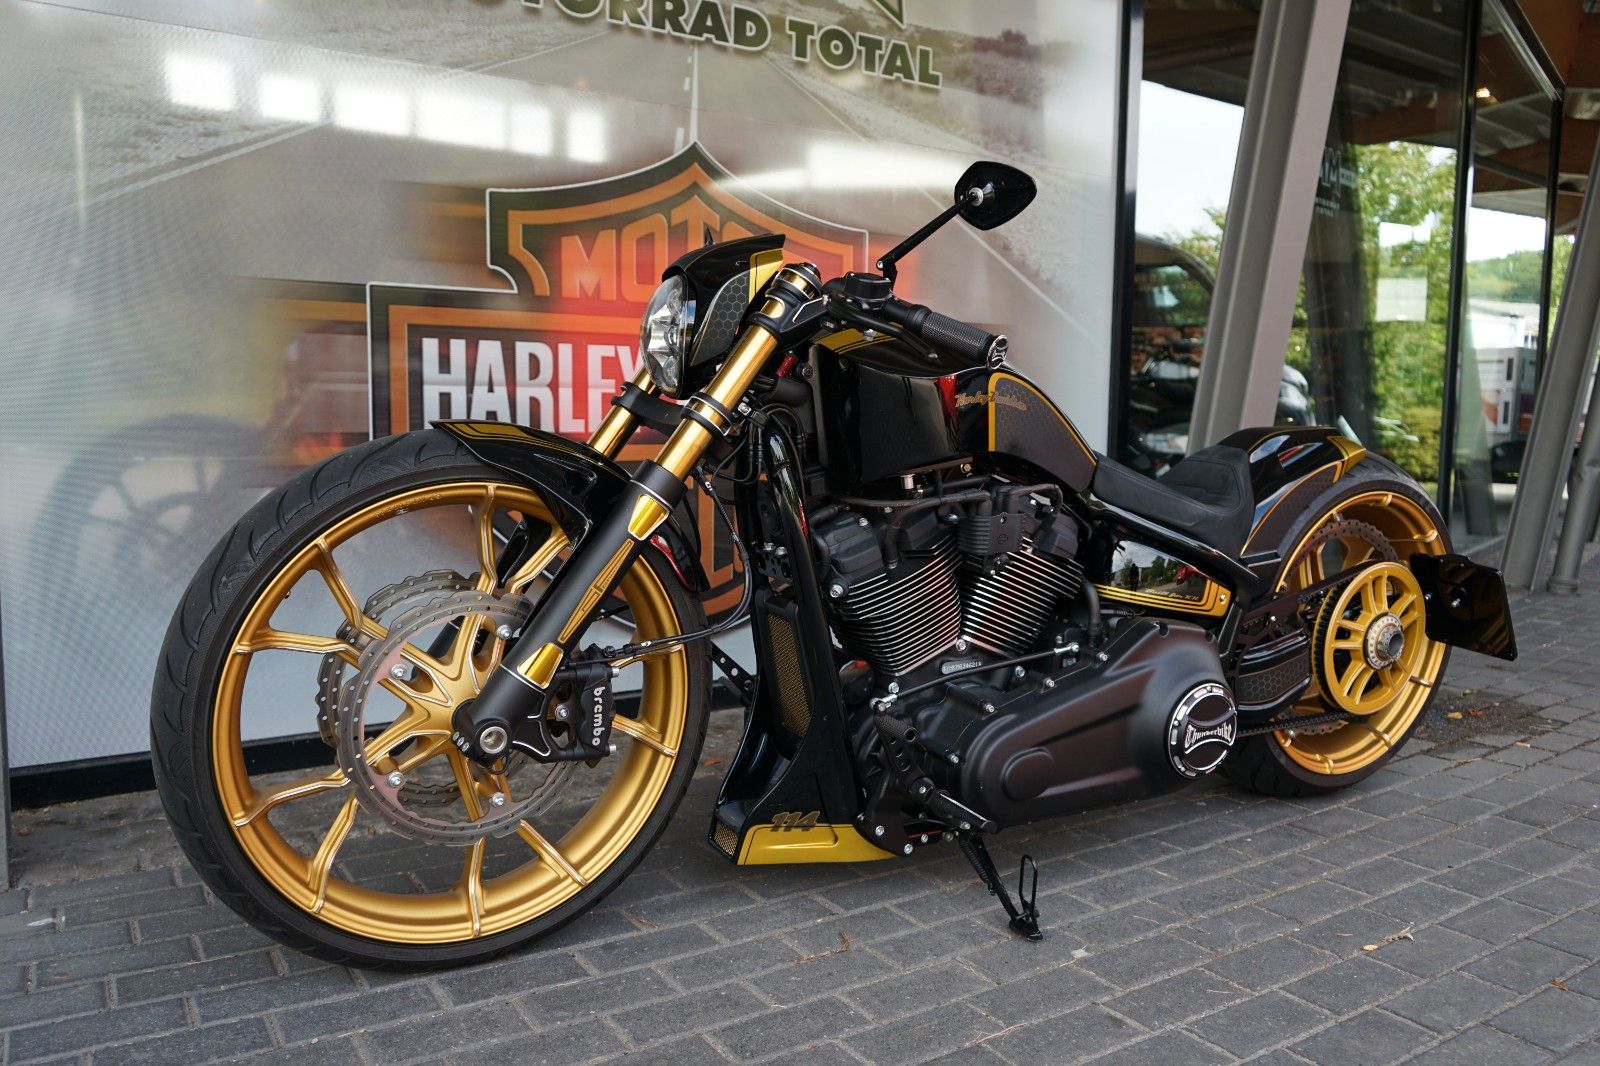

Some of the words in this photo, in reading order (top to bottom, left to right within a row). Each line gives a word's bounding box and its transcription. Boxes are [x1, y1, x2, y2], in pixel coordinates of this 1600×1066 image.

[785, 18, 942, 88] TOTAL
[560, 195, 755, 303] MOT
[592, 686, 606, 747] brembo
[771, 811, 820, 832] 114
